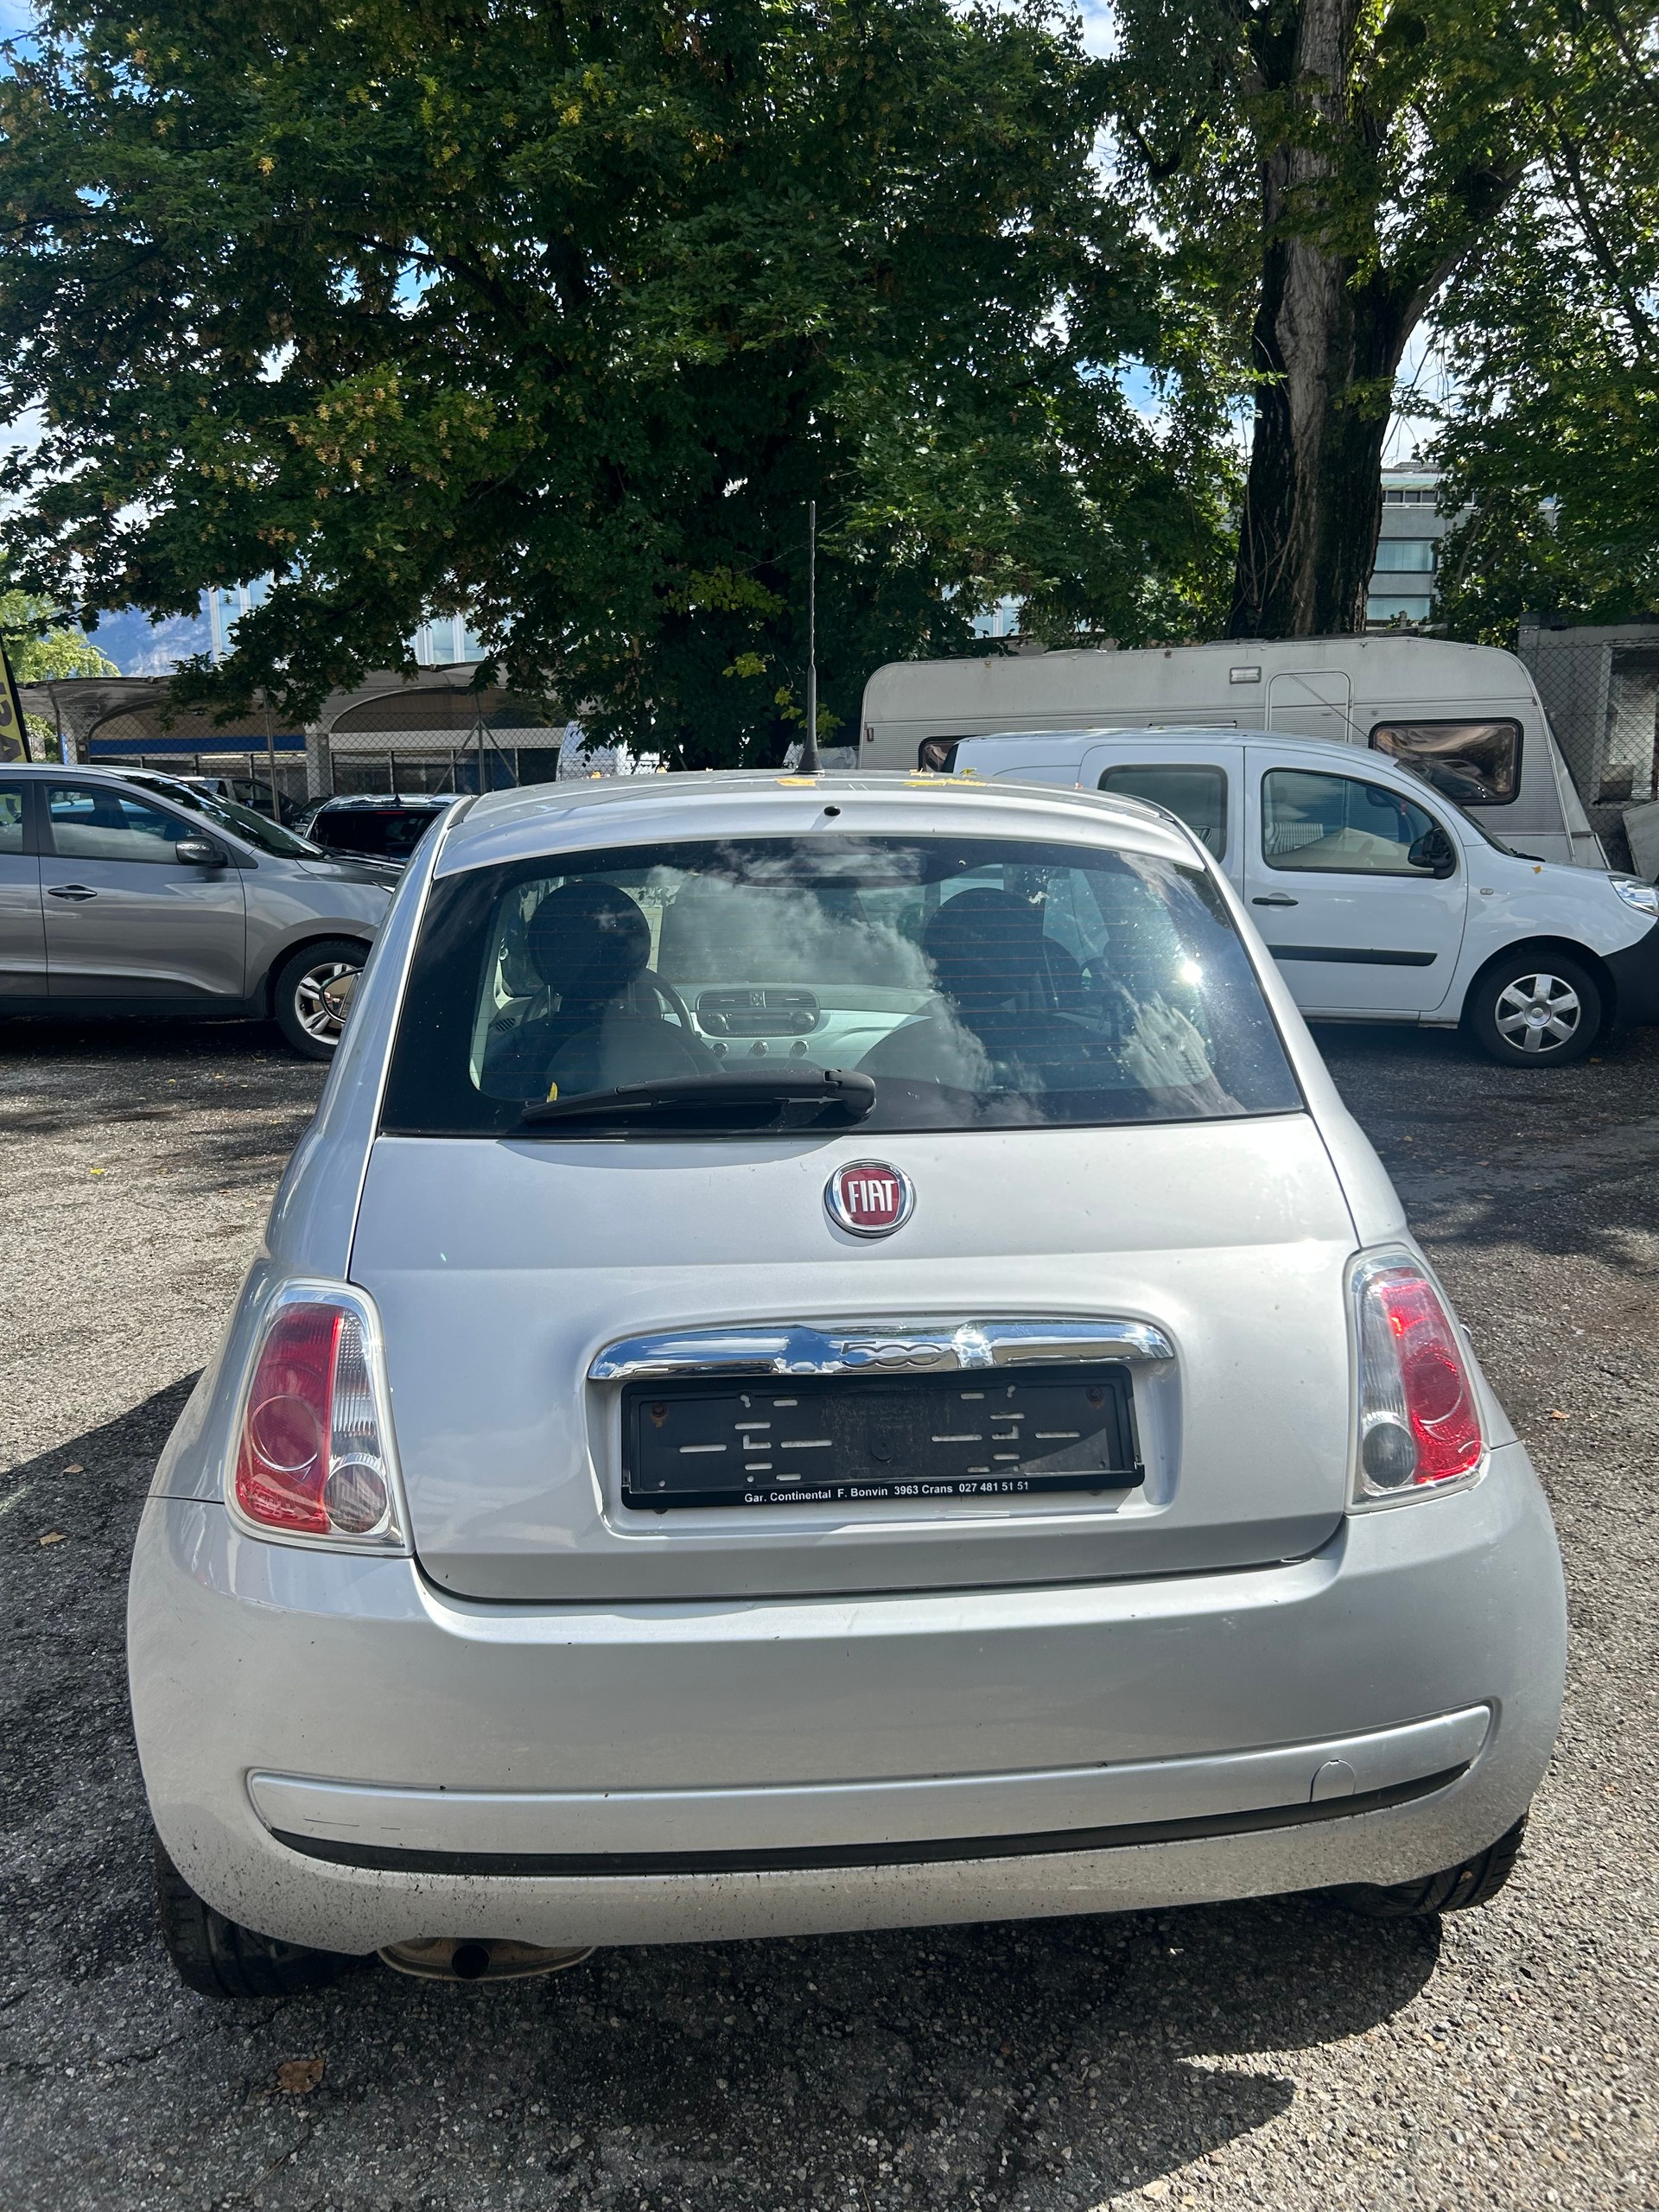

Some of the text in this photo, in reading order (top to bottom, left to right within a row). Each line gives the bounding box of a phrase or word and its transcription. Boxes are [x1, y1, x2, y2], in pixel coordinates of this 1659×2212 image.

[847, 1179, 898, 1213] FIAT
[840, 1340, 943, 1370] 500
[744, 1481, 1029, 1503] Gar. Continental F. Bonvin 3963 Crans 027 481 51 51
